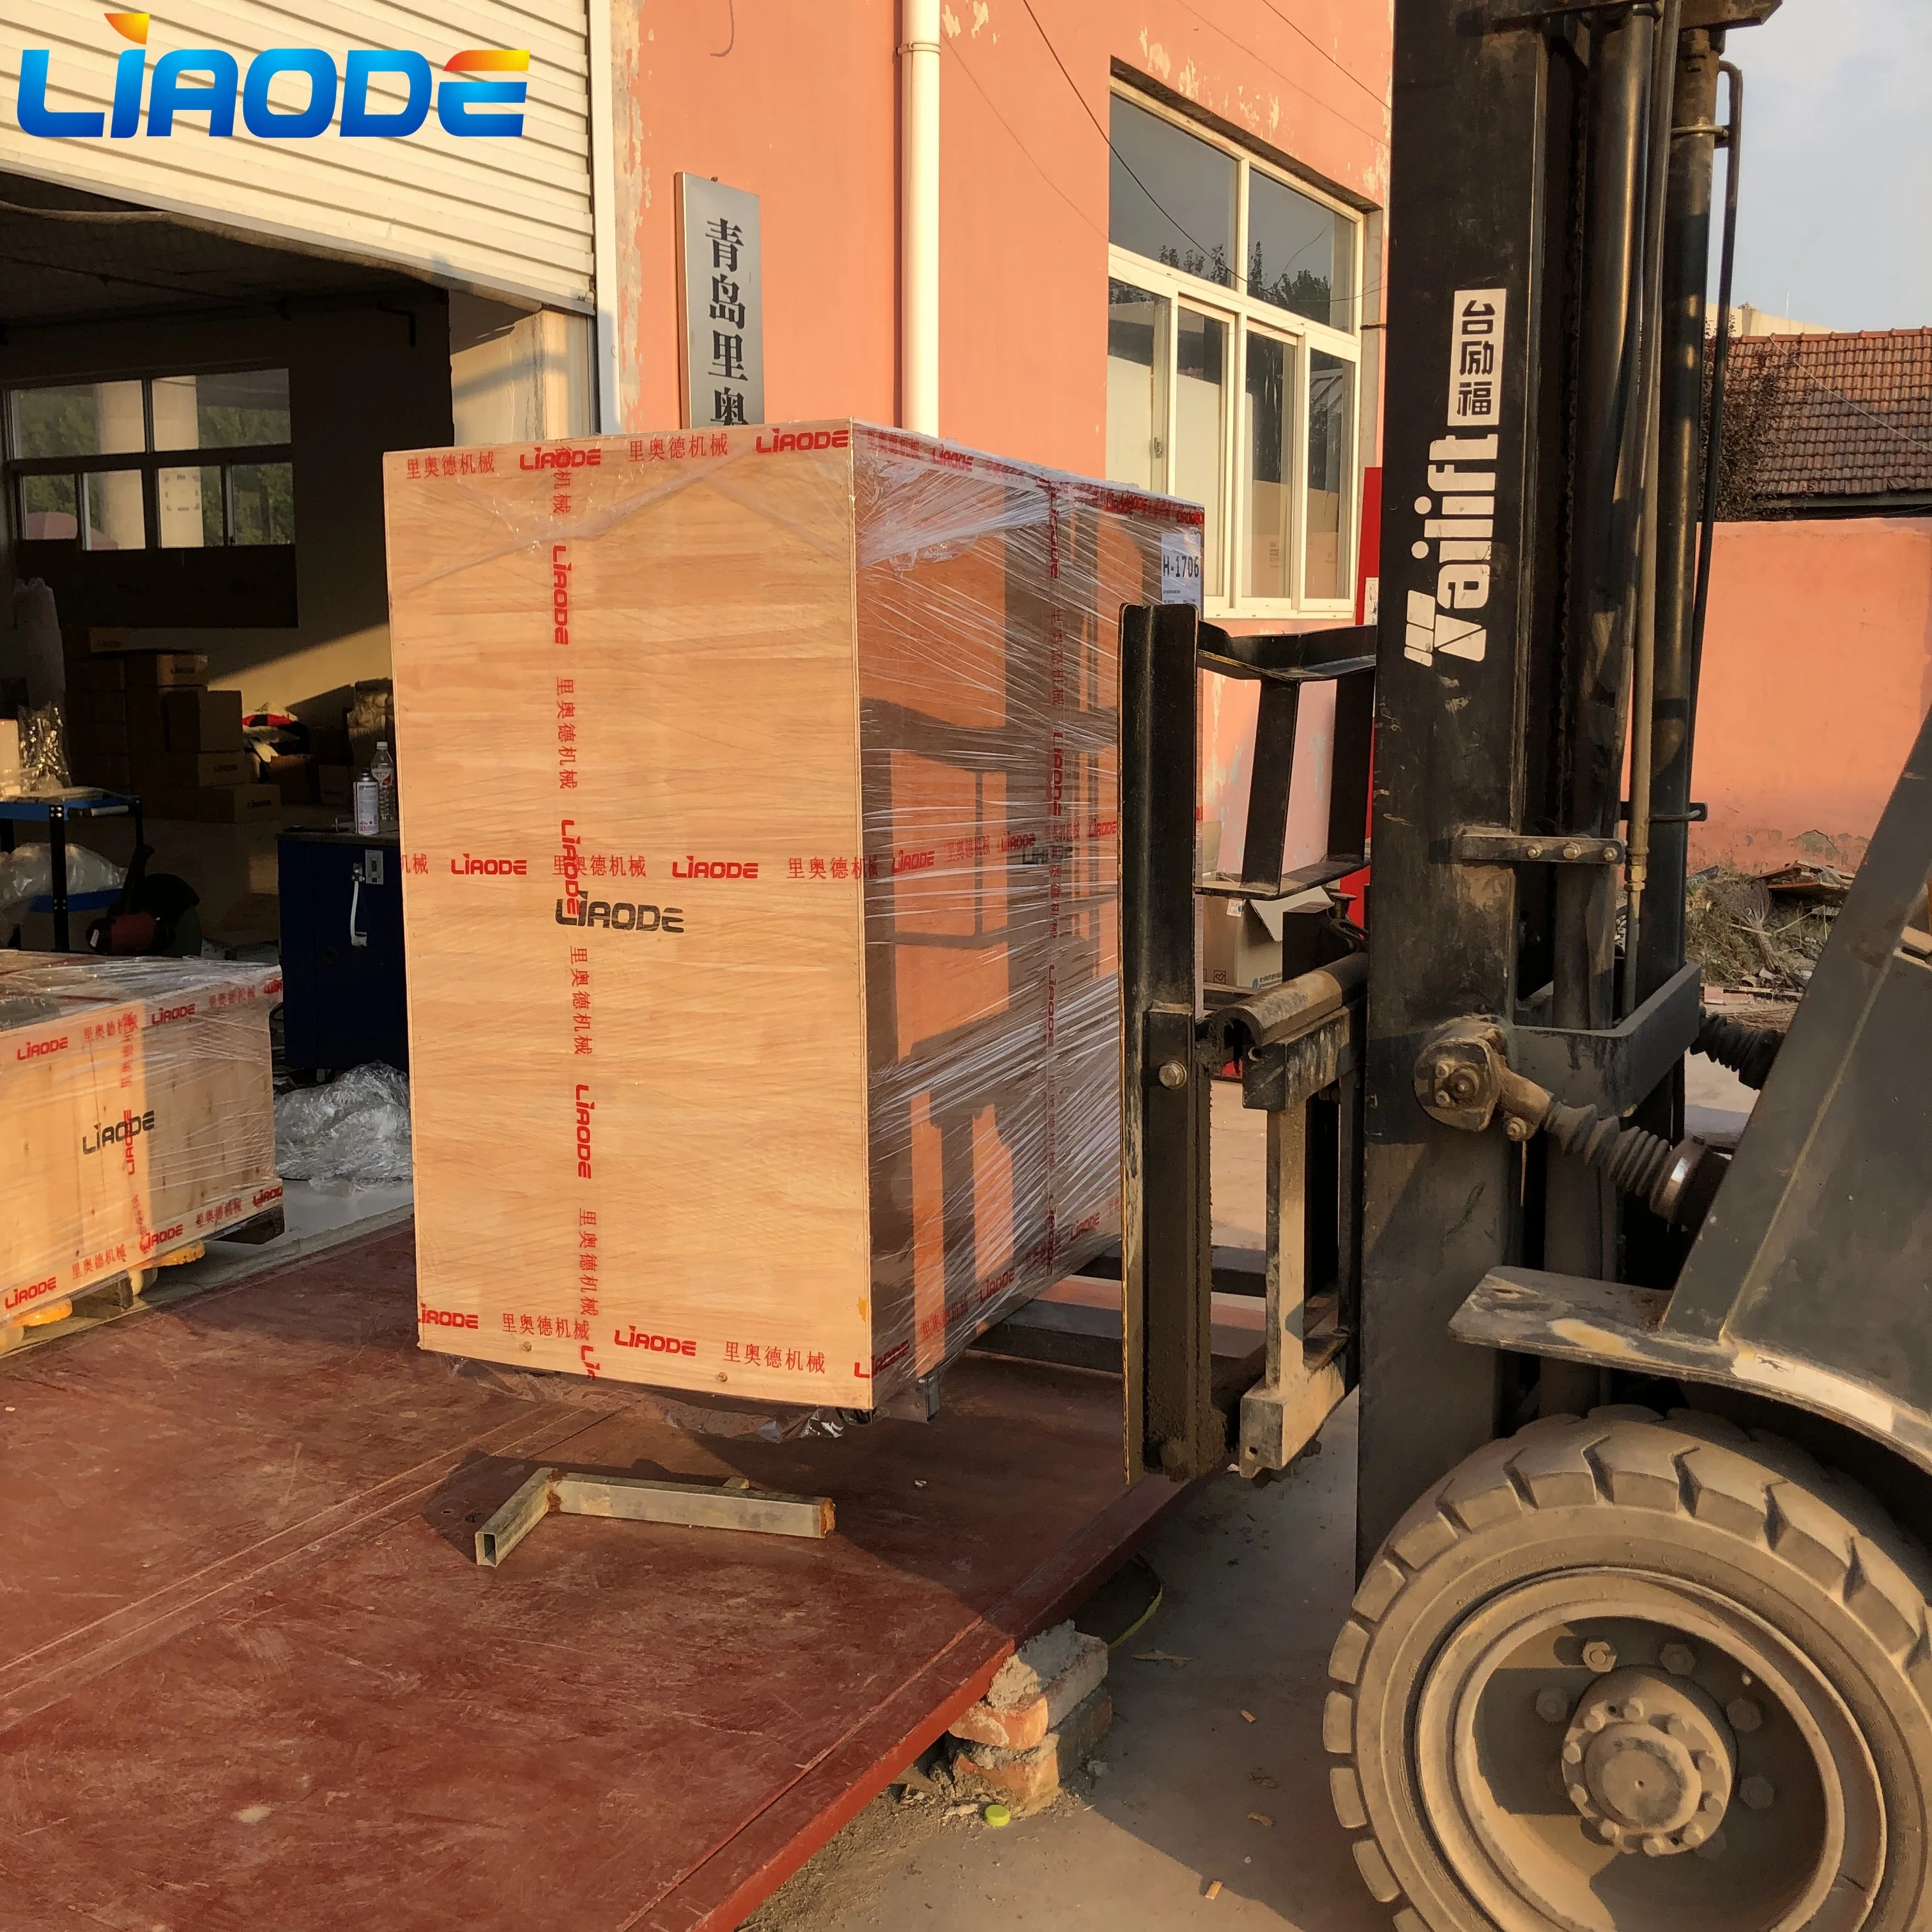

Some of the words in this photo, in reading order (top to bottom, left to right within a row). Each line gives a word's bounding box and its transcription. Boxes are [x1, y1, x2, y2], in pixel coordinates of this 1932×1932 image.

[705, 218, 748, 426] 青岛里奥
[1457, 300, 1496, 416] 台励福
[628, 433, 728, 462] 里奥德机械
[406, 451, 494, 479] 里奥德机械
[1163, 555, 1199, 578] H-1706
[556, 677, 578, 789] 里奥德机械
[552, 854, 646, 877] 里奥德机械
[571, 946, 592, 1054] 里奥德机械
[579, 1208, 598, 1317] 里奥德机械
[502, 1313, 589, 1340] 里奥德机械
[723, 1341, 825, 1374] 里奥德机械
